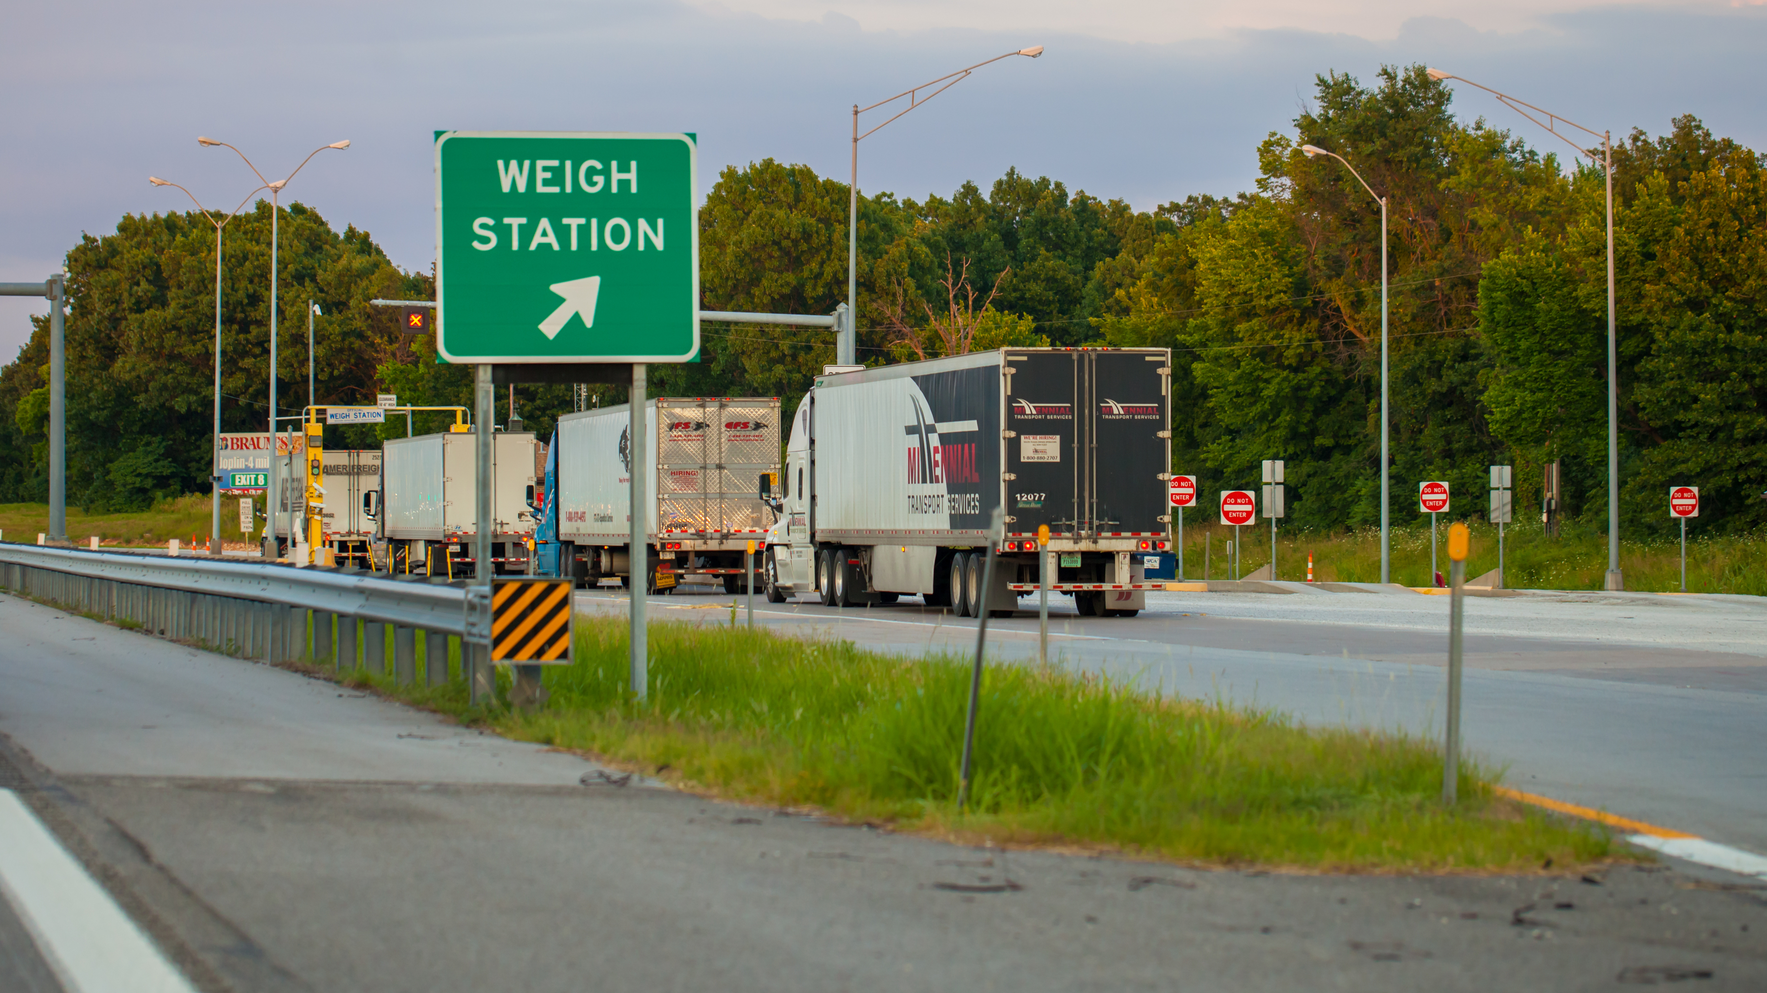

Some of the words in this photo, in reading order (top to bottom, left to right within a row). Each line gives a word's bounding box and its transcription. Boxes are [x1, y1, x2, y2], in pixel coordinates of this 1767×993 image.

[497, 159, 637, 193] WEIGH
[471, 217, 664, 251] STATION
[235, 474, 256, 485] EXIT
[258, 474, 265, 485] 8
[908, 494, 944, 514] TRANSPORT
[947, 493, 980, 514] SERVICES
